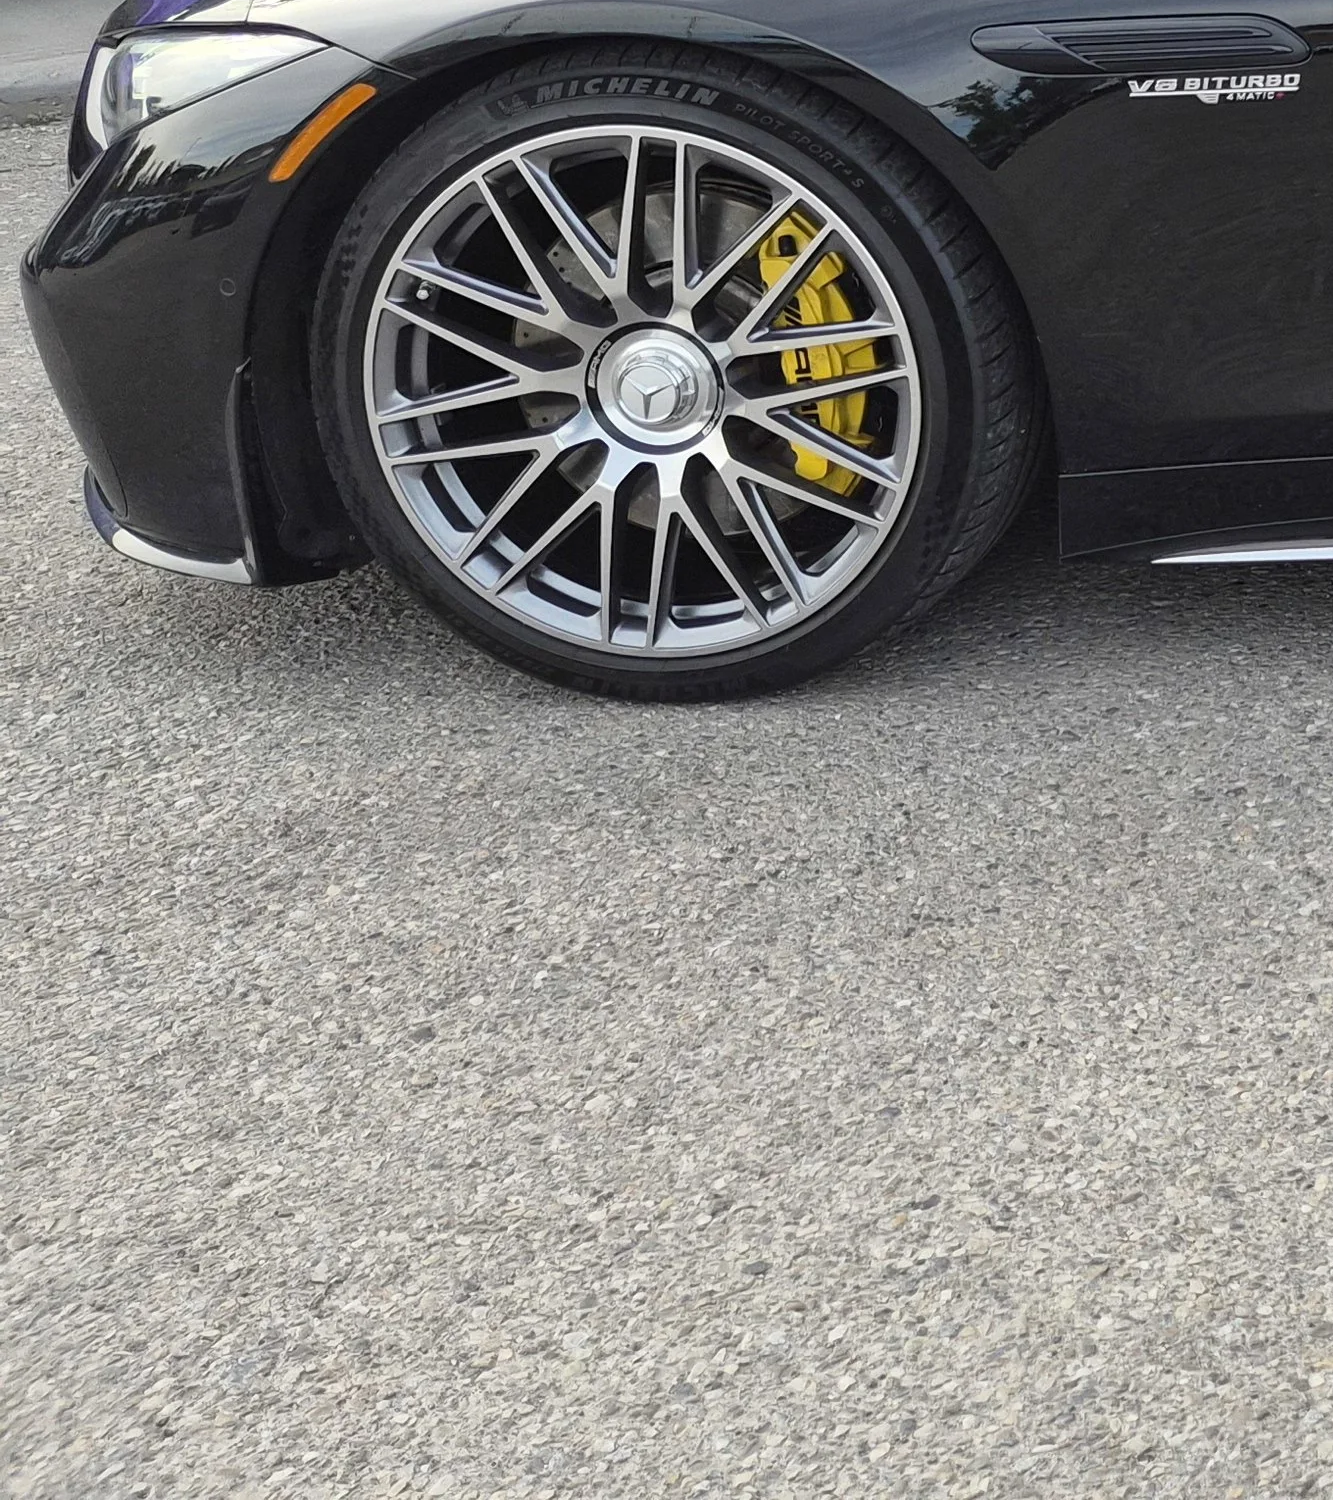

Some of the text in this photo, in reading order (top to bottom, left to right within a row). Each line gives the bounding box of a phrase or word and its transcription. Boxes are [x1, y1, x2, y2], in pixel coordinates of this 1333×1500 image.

[1128, 73, 1301, 93] V8 BITURBO
[536, 76, 720, 106] MICHELIN
[733, 103, 786, 131] PILOT
